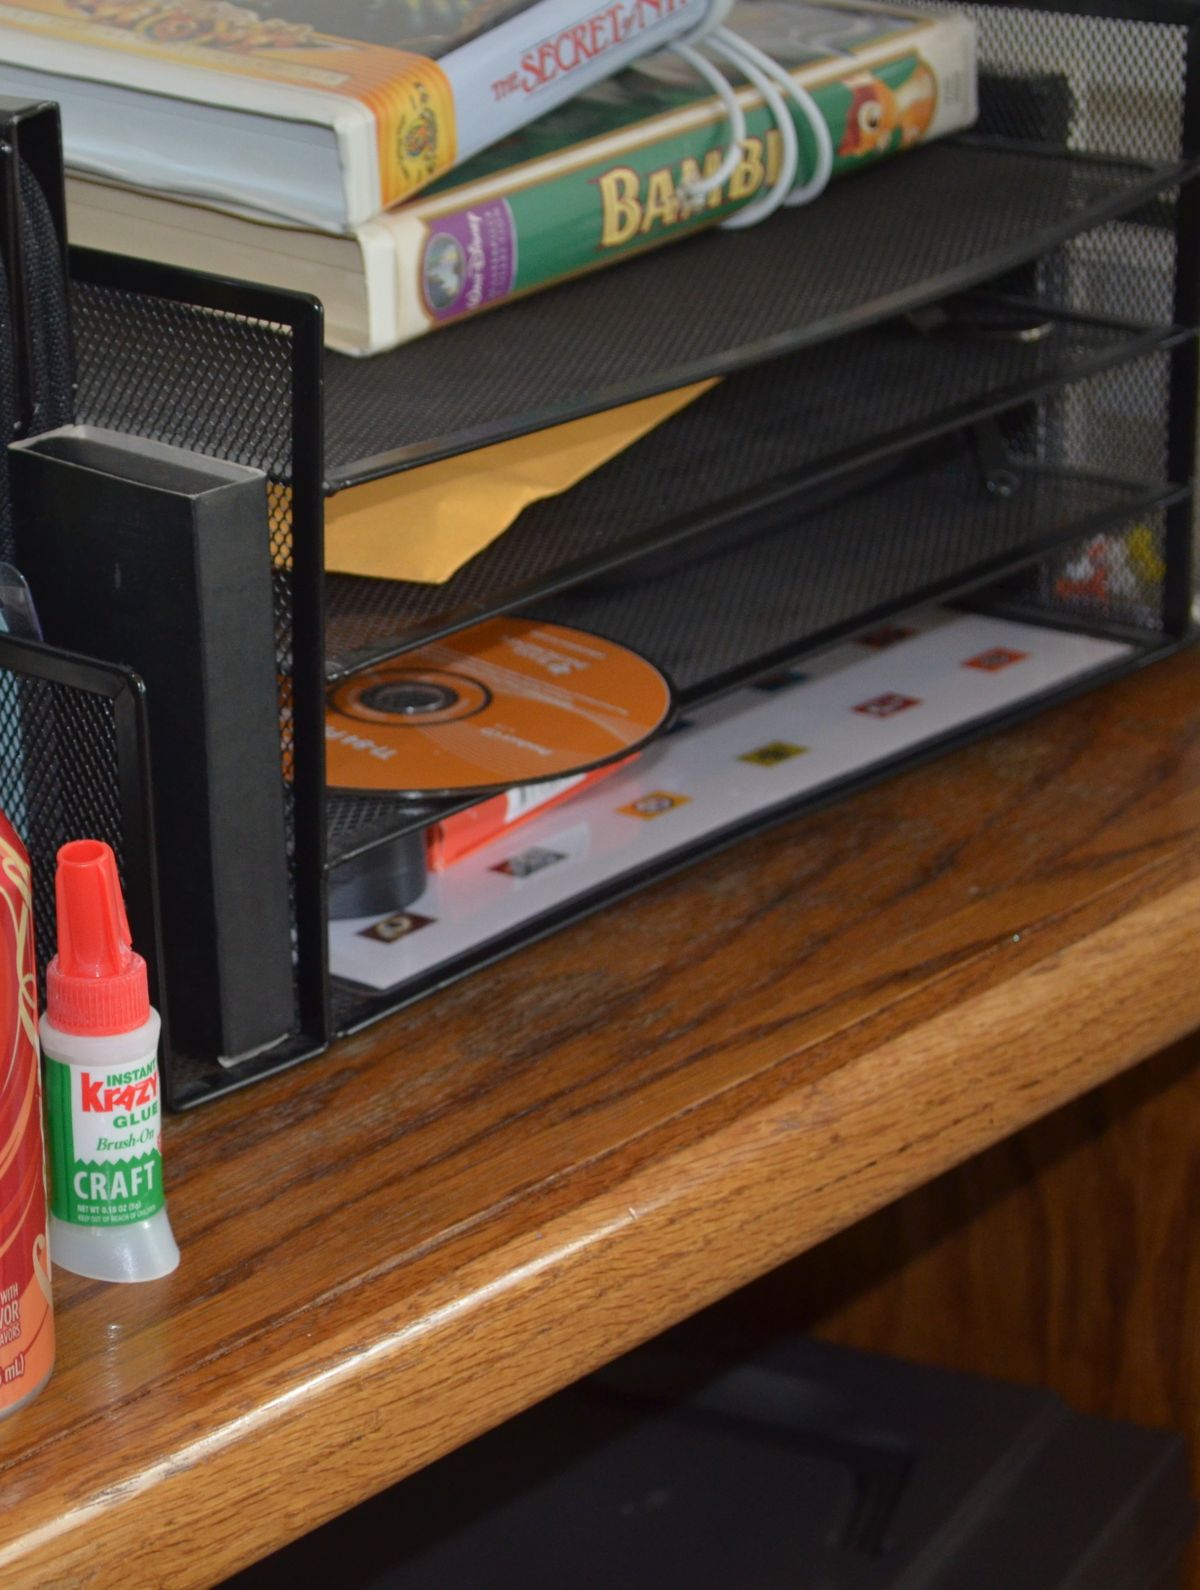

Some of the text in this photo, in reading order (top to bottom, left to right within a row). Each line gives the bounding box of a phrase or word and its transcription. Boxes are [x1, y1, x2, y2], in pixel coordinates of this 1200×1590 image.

[491, 71, 519, 100] THE
[520, 3, 624, 93] SECRET
[112, 1102, 159, 1128] GLUE
[96, 1128, 155, 1151] Brush-On
[74, 1160, 156, 1200] CRAFT
[0, 1282, 19, 1303] WITH
